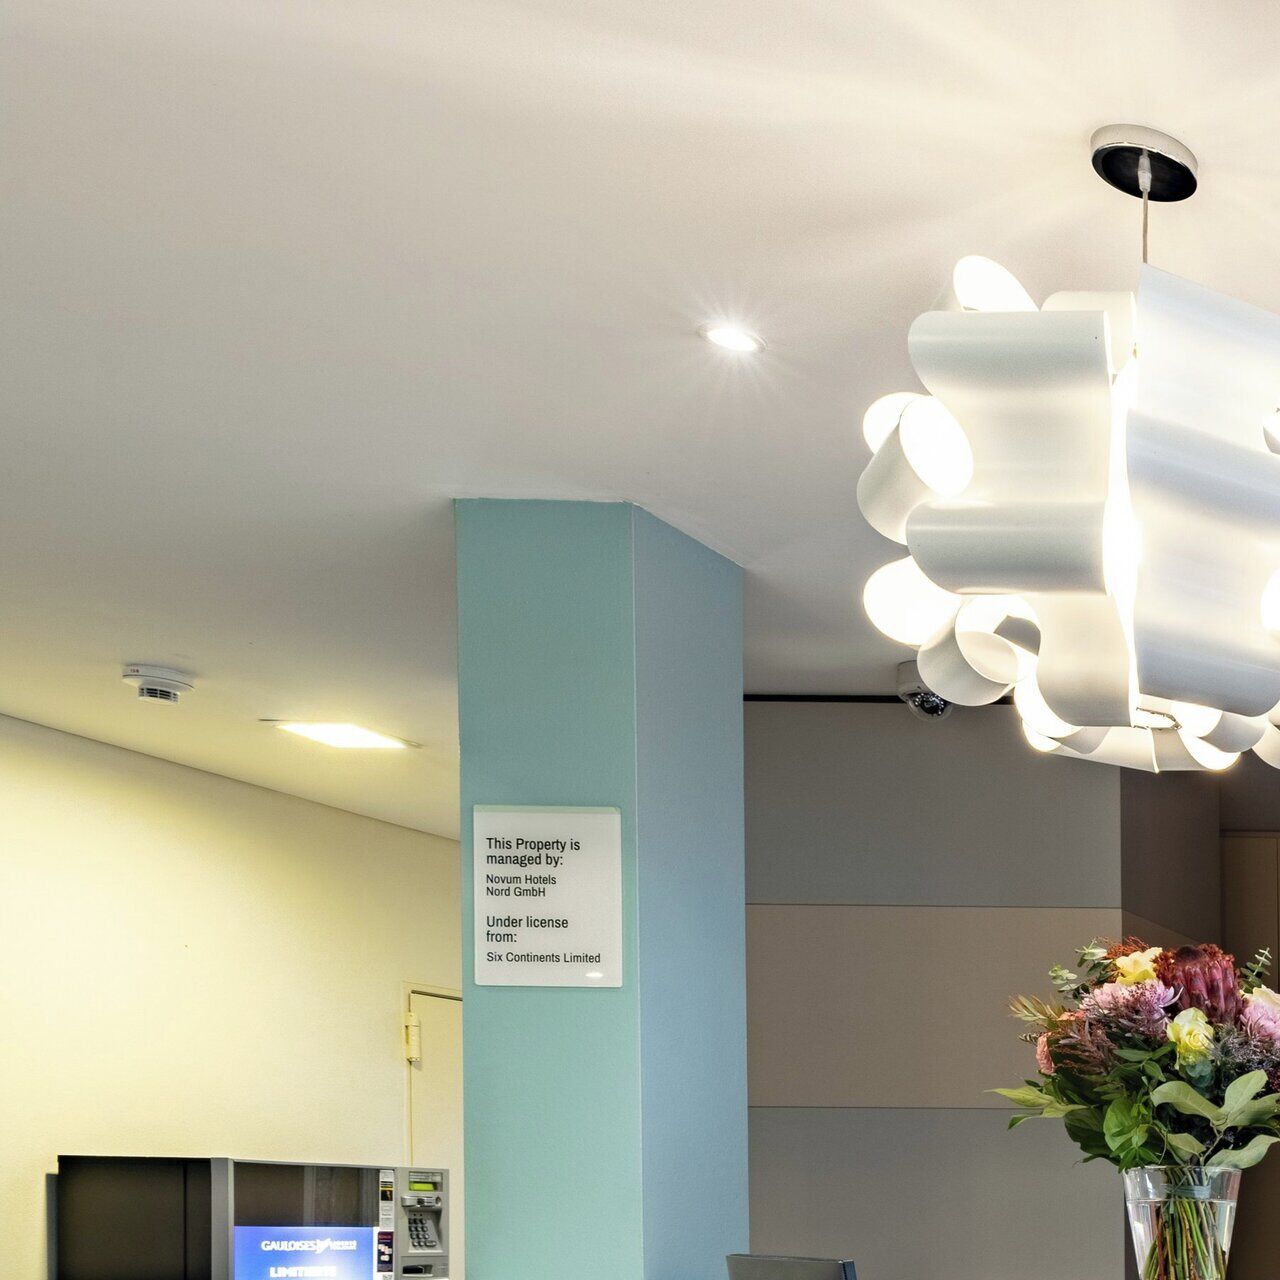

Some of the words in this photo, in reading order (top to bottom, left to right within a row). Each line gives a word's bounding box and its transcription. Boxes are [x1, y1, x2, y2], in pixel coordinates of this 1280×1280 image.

[486, 837, 512, 850] This
[516, 838, 566, 853] Property
[570, 838, 581, 852] is
[486, 854, 541, 867] managed
[545, 853, 564, 868] by:
[486, 874, 522, 885] Novum
[524, 874, 557, 886] Hotels
[486, 886, 511, 897] Nord
[513, 886, 546, 898] GmbH
[486, 916, 522, 928] Under
[526, 916, 569, 929] license
[486, 930, 518, 943] from:
[486, 951, 502, 963] Six
[506, 951, 561, 963] Continents
[563, 952, 601, 964] Limited
